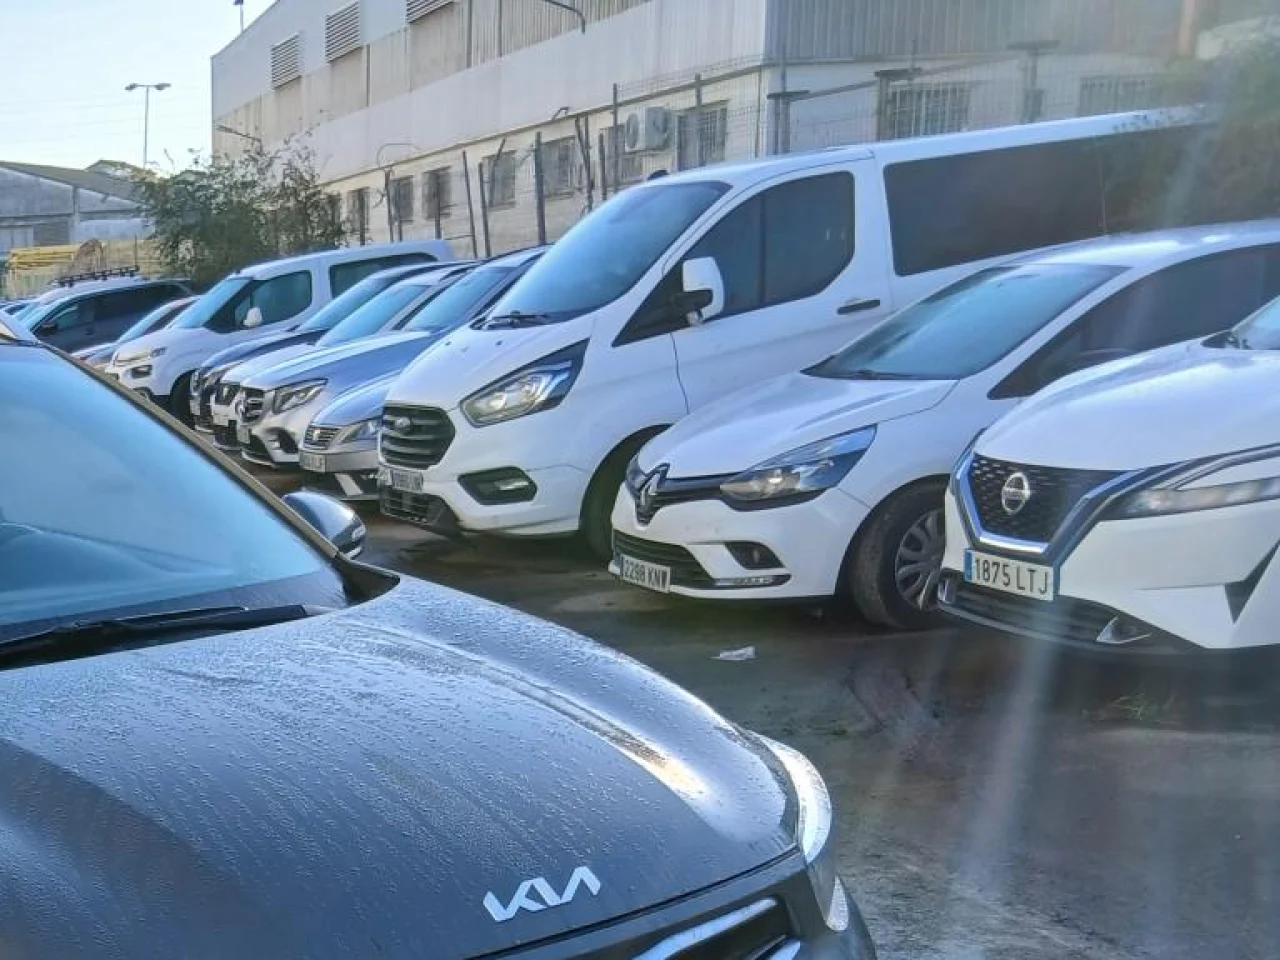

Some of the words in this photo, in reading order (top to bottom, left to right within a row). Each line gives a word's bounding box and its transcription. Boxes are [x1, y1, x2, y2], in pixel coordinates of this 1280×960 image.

[975, 558, 1010, 587] 1875
[1016, 566, 1048, 595] LTJ
[483, 866, 601, 922] KIA
